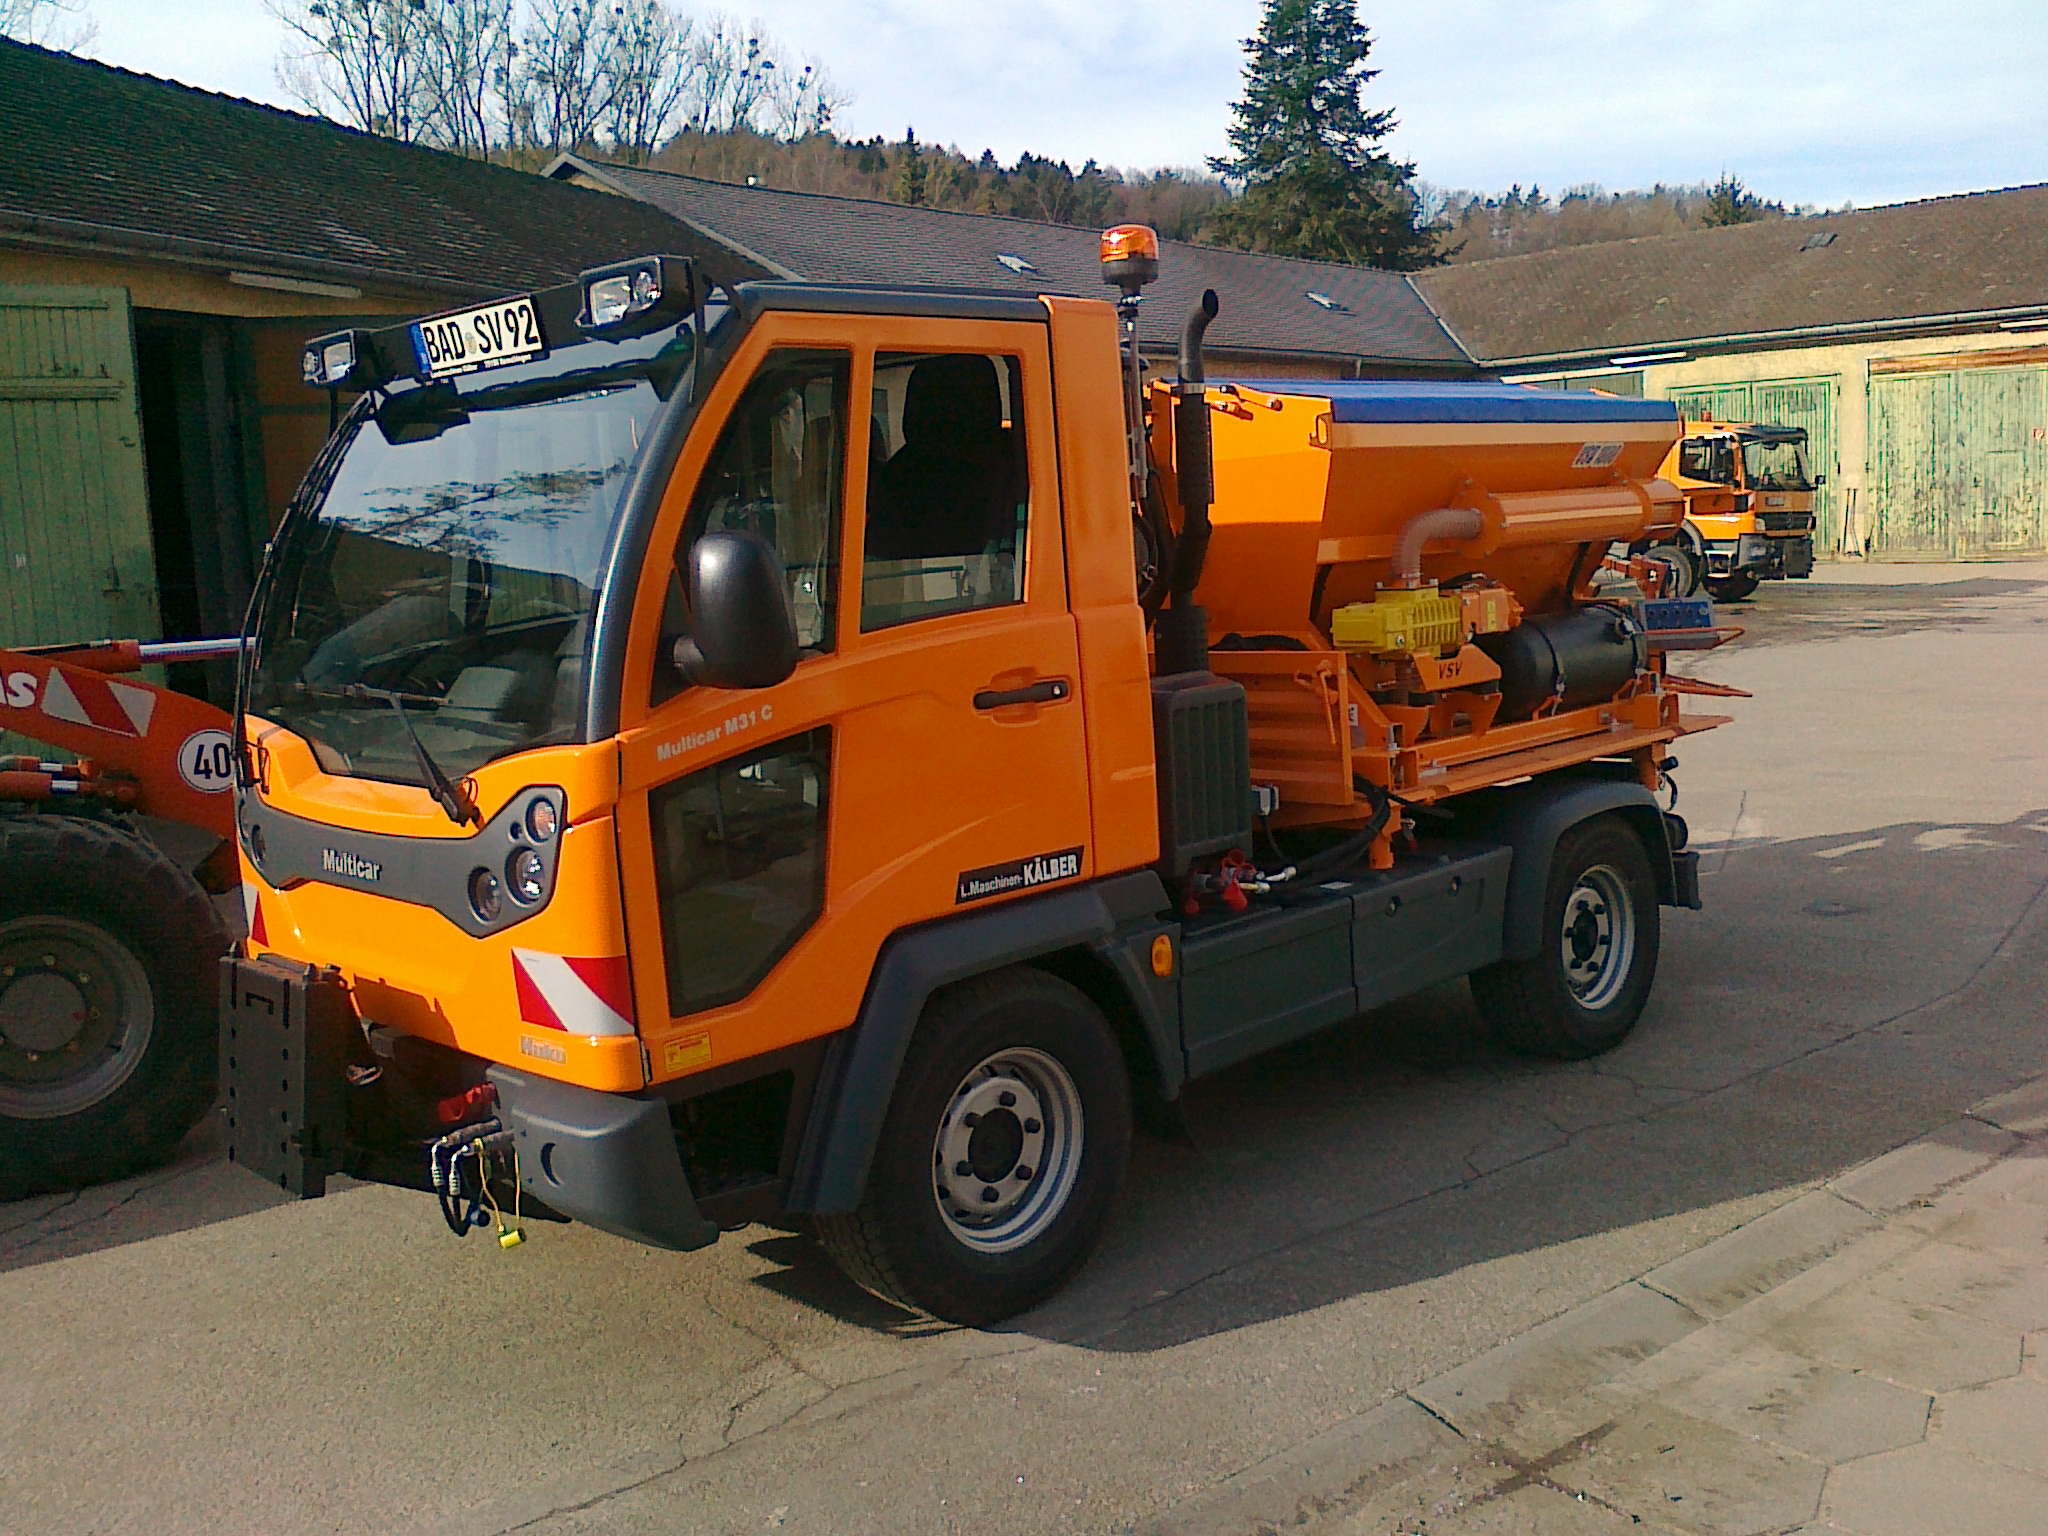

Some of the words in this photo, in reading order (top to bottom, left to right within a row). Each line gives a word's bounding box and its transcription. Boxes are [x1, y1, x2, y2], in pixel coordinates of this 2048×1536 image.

[422, 321, 466, 364] BAD
[473, 310, 503, 354] SV
[504, 303, 540, 349] 92
[1439, 660, 1464, 680] VSV
[656, 724, 722, 762] Multicar
[724, 710, 757, 737] M31
[760, 703, 774, 721] C
[193, 742, 232, 780] 40
[322, 848, 380, 881] Multicar
